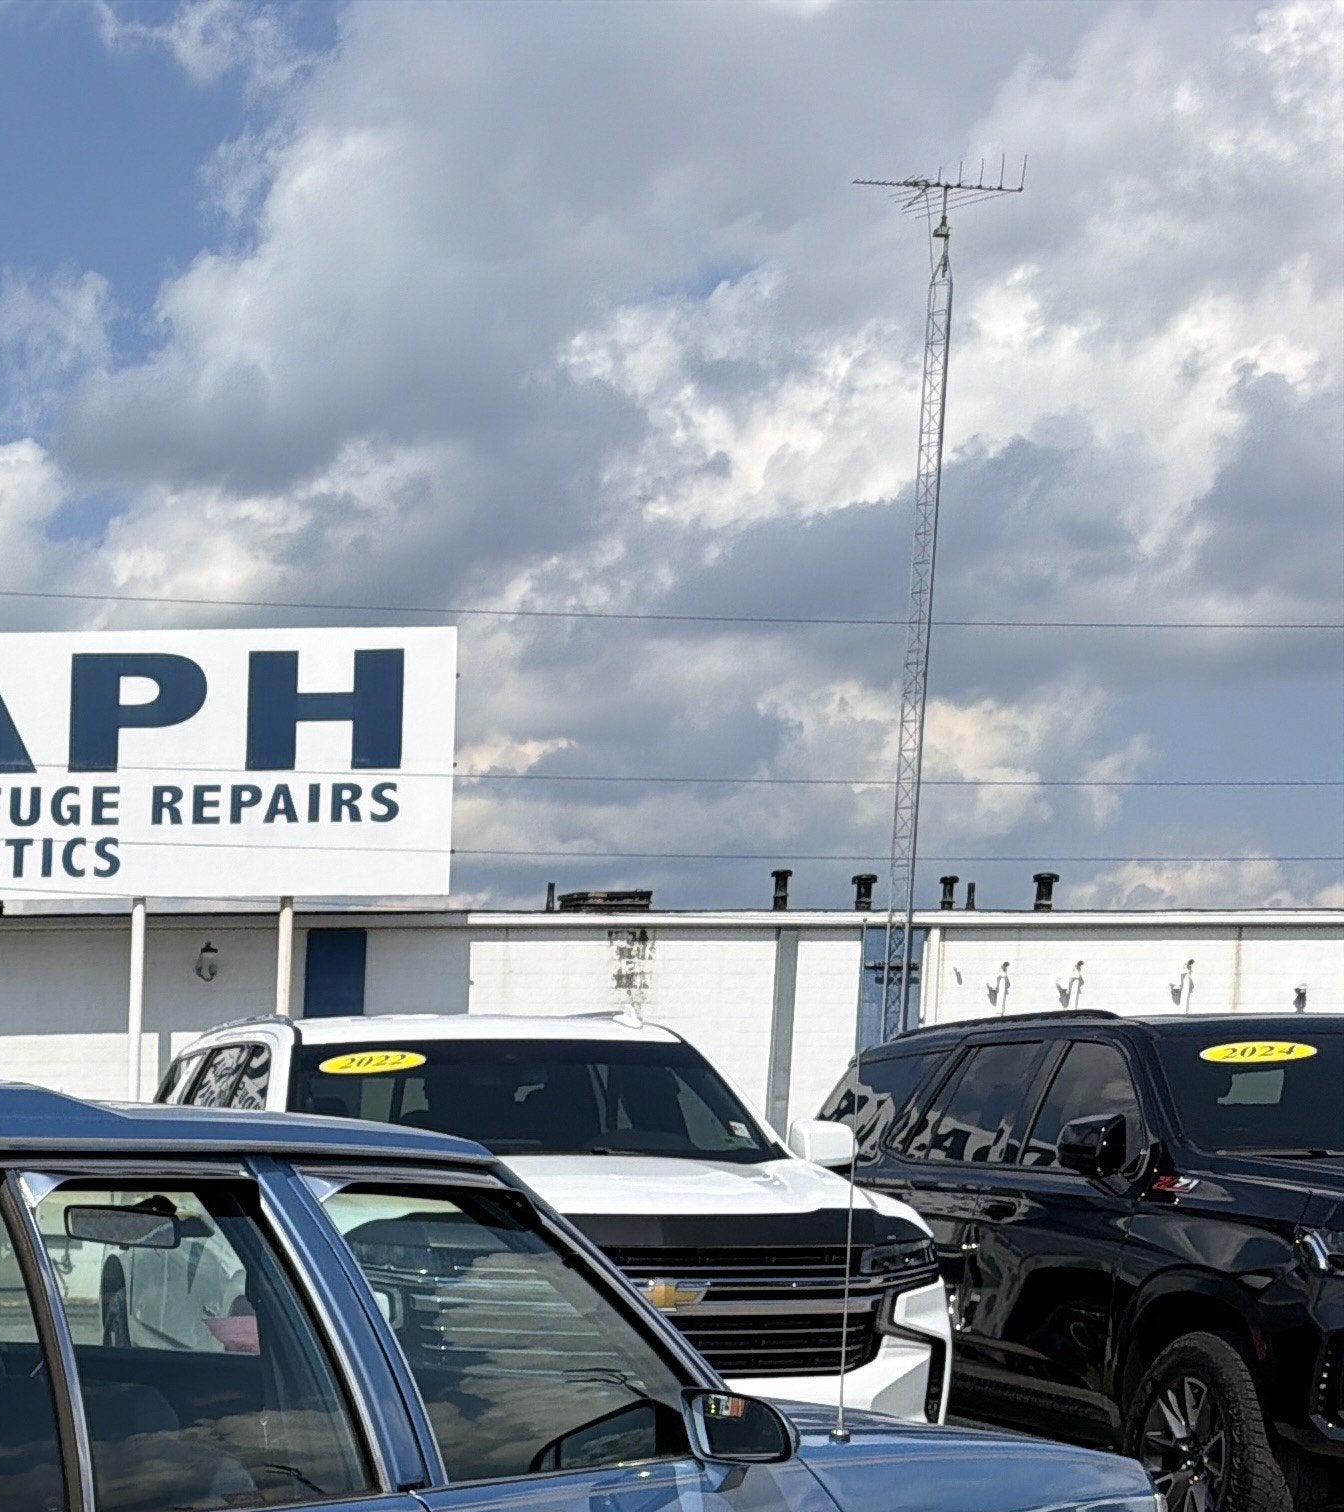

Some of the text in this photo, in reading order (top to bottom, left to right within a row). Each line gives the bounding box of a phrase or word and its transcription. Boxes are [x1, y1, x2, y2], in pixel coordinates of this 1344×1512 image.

[150, 781, 401, 826] REPAIRS
[1221, 1044, 1297, 1060] 2024
[338, 1053, 407, 1070] 2022
